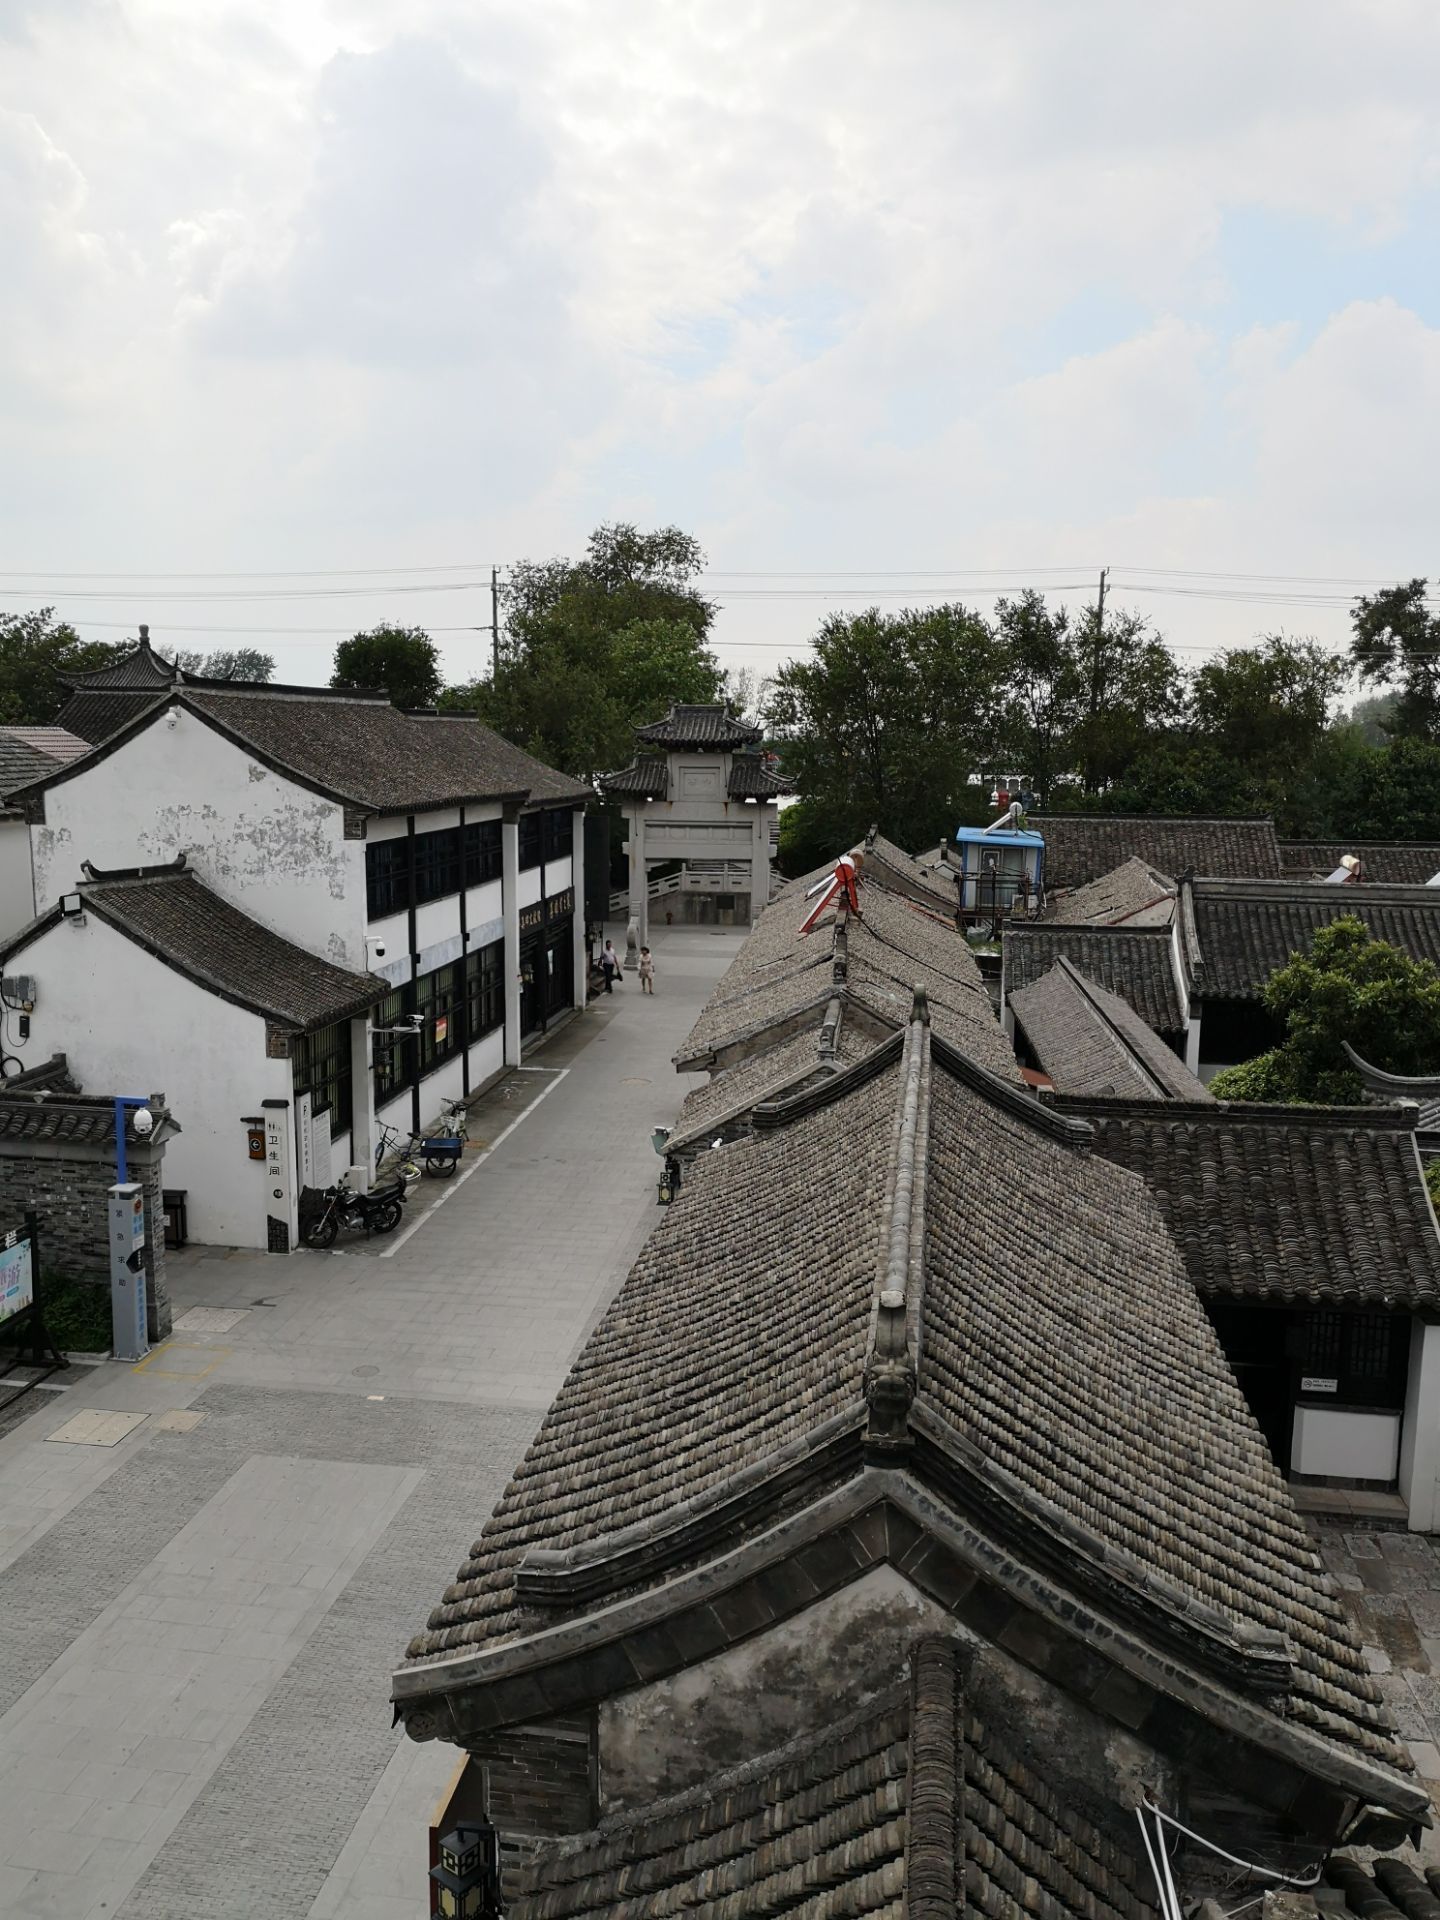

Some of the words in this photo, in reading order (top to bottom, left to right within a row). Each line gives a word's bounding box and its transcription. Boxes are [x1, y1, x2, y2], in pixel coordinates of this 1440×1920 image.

[269, 1136, 280, 1176] 卫生间
[116, 1209, 126, 1287] 紧急求助
